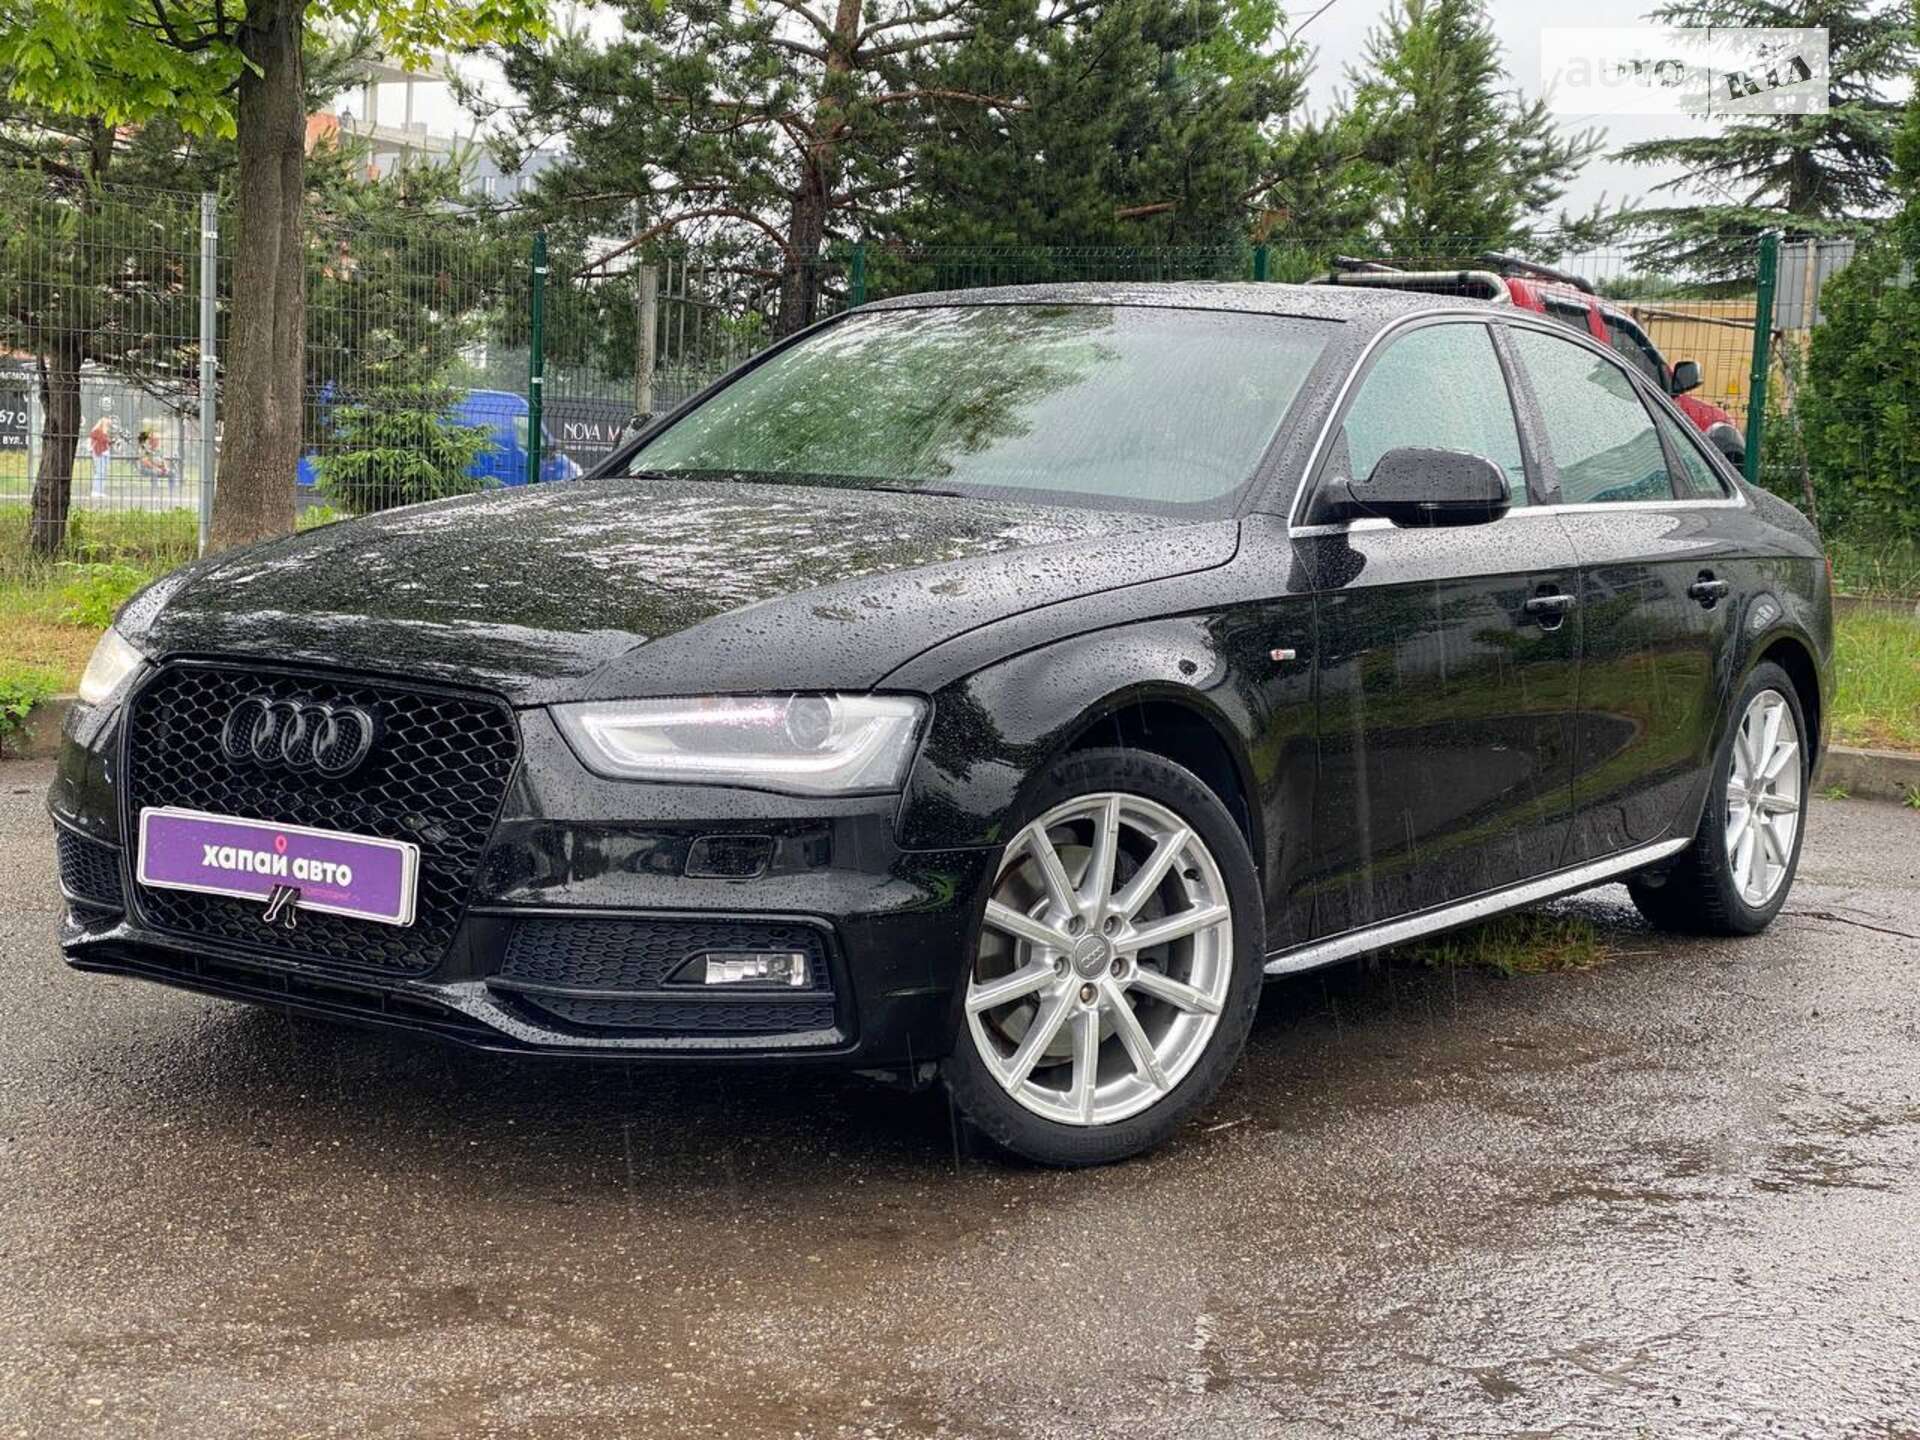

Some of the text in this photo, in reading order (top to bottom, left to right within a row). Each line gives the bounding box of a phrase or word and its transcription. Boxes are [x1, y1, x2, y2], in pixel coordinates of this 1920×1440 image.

[563, 422, 601, 440] NOVA
[202, 836, 352, 887] хапай авто
